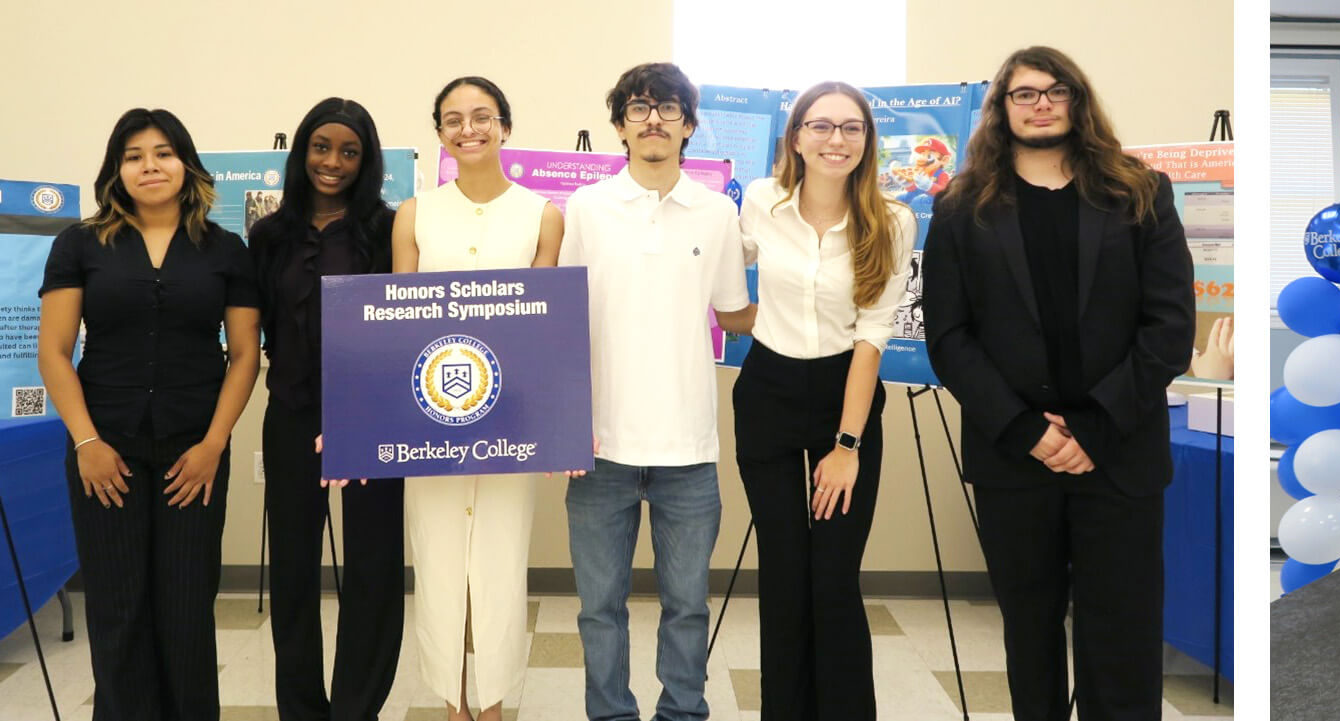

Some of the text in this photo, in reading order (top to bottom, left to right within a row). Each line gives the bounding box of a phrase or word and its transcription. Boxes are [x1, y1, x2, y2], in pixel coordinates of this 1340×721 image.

[715, 93, 748, 105] Abstract
[780, 101, 793, 111] Ha
[890, 97, 905, 107] the
[907, 96, 928, 108] Age
[929, 96, 942, 106] of
[943, 95, 962, 105] AI?
[1157, 150, 1187, 159] Being
[546, 161, 612, 172] UNDERSTANDING
[1167, 161, 1187, 169] That
[1191, 160, 1198, 168] is
[215, 171, 224, 181] in
[225, 171, 262, 181] America
[532, 168, 615, 181] Absence Epilep
[1184, 170, 1207, 179] Care
[385, 280, 525, 300] Honors Scholars
[363, 300, 547, 321] Research Symposium
[423, 337, 489, 358] BERKELEY COLLEGE
[424, 403, 489, 424] HONORS PROGRAM
[396, 438, 536, 464] Berkeley College
